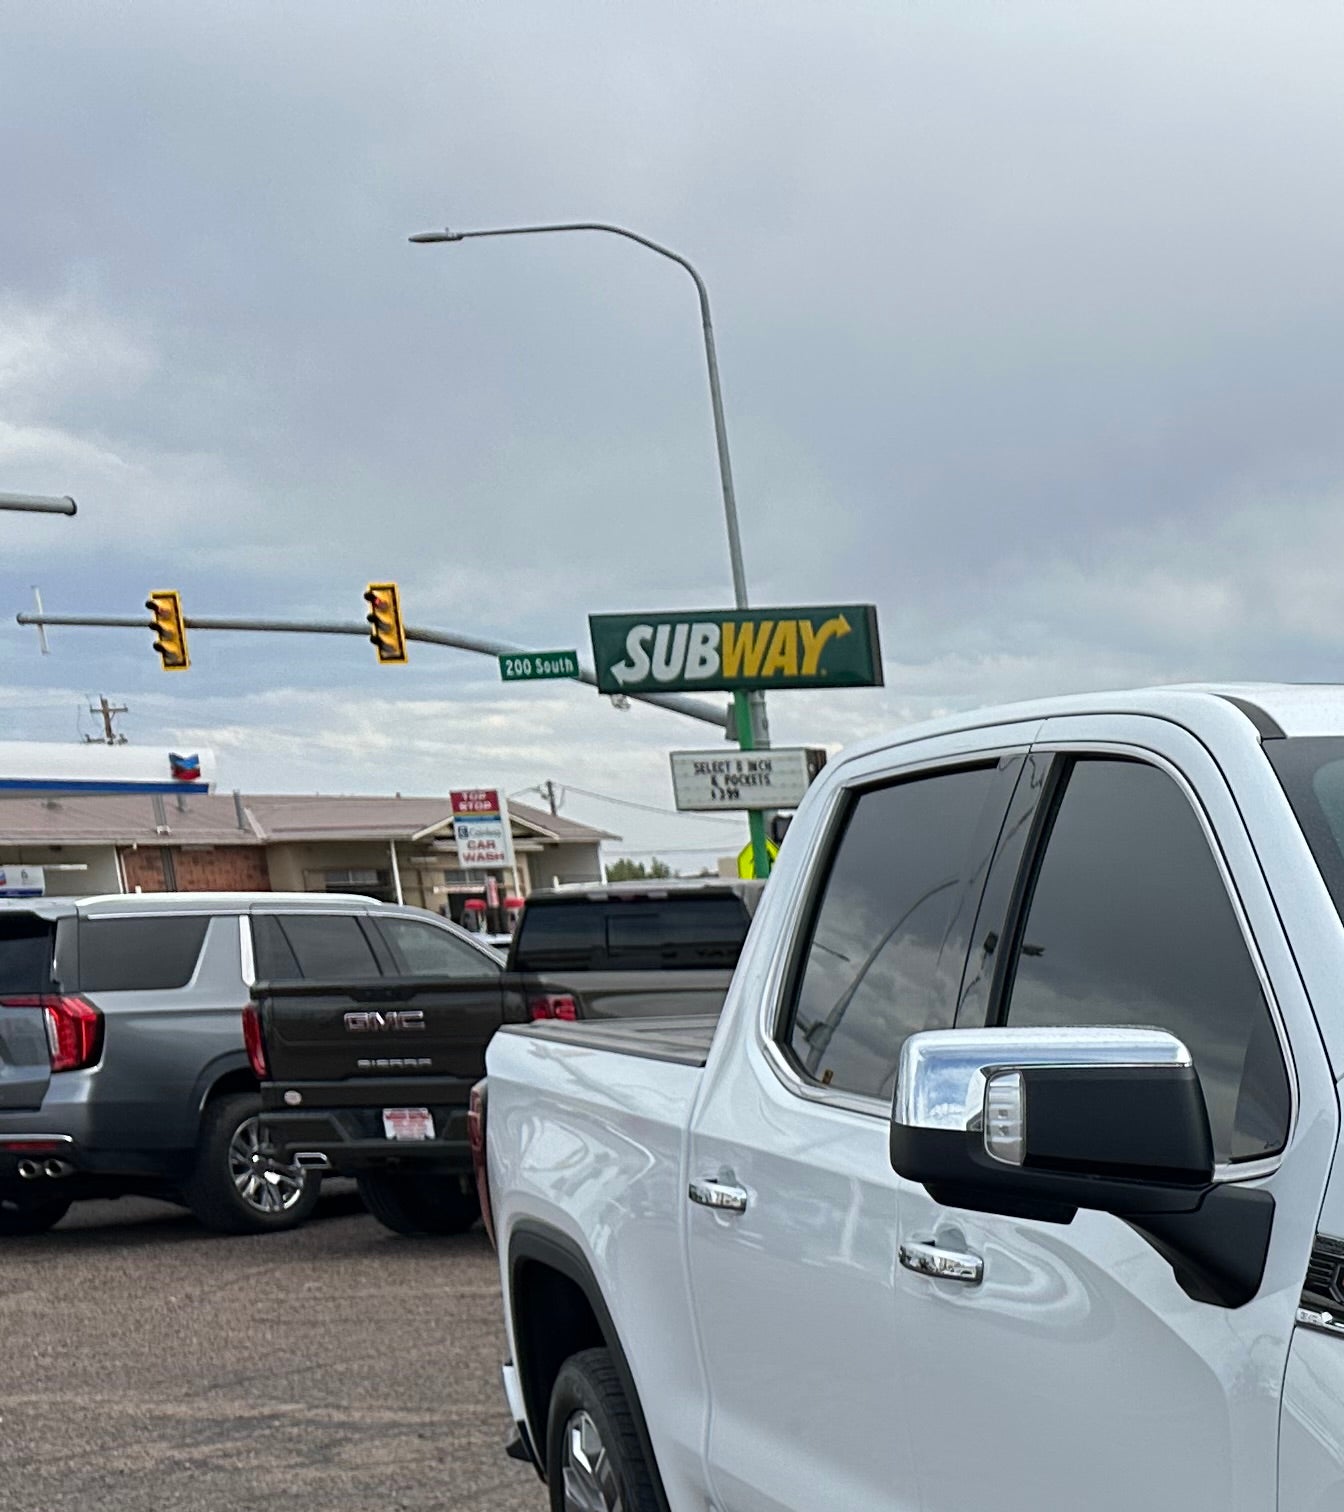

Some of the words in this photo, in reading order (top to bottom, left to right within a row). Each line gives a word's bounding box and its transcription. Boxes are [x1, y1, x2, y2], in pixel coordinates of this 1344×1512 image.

[610, 613, 852, 686] SUBWAY
[505, 658, 532, 677] 200
[535, 656, 574, 675] South
[693, 760, 730, 776] SELECT
[724, 773, 772, 787] POCKETS
[467, 839, 496, 850] CAR
[462, 850, 505, 862] WASH
[344, 1010, 426, 1032] GMC
